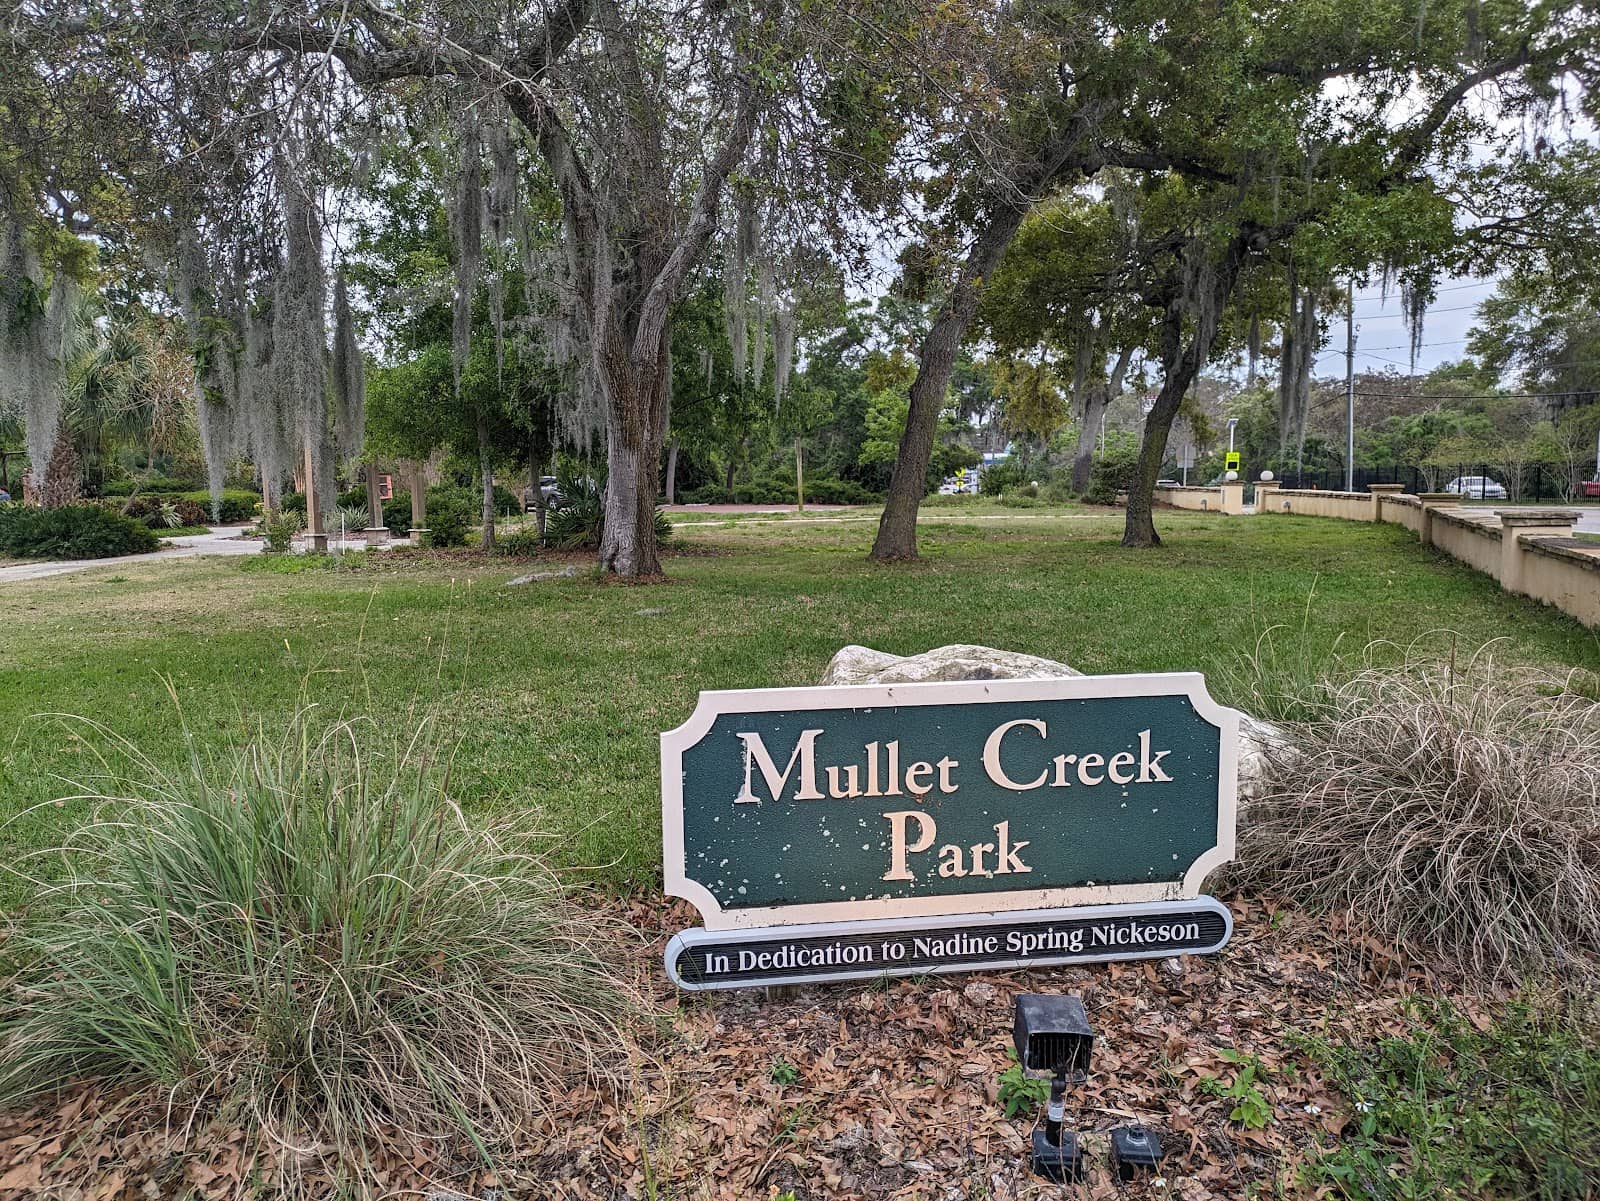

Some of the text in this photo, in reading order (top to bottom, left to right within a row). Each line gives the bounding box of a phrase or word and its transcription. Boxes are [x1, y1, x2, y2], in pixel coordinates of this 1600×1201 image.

[733, 718, 1174, 804] Mullet Creek
[882, 810, 1033, 881] Park
[704, 921, 1200, 974] In Dedication to Nadine Spring Nickeson
